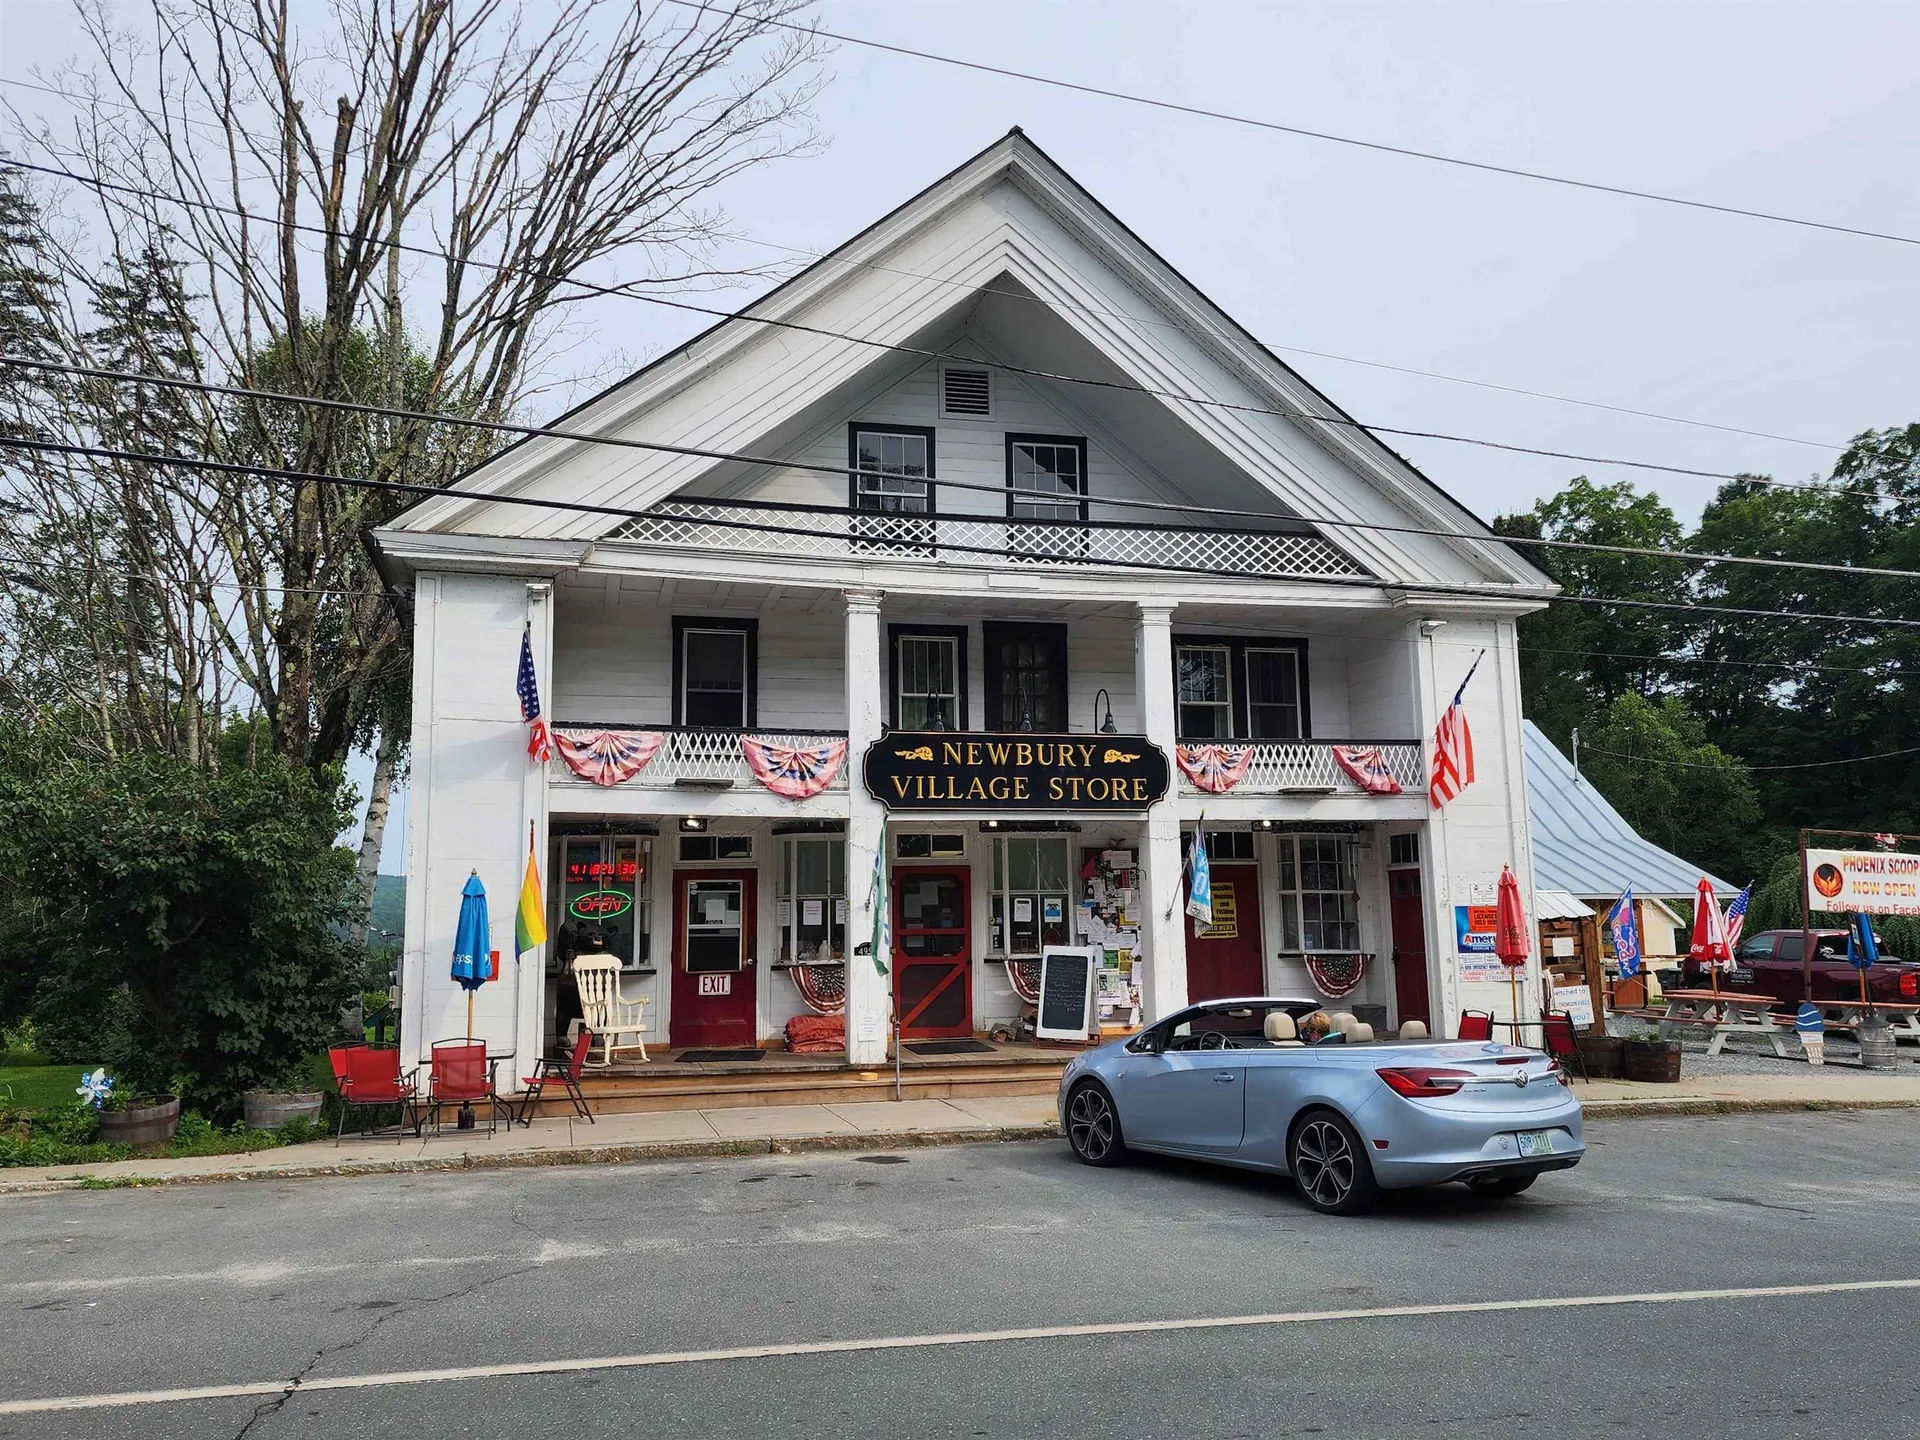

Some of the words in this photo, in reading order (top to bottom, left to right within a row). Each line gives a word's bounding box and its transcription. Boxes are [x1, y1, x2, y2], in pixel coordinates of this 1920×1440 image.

[942, 742, 1097, 767] NEWBURY
[890, 775, 1030, 801] VILLAGE
[1049, 776, 1149, 801] STORE
[1843, 855, 1886, 874] PHOENIX
[1888, 858, 1920, 876] SCOOP
[1852, 881, 1880, 895] NOW
[1884, 882, 1916, 897] OPEN
[578, 896, 623, 912] OPEN
[1826, 900, 1860, 913] Follow
[1863, 905, 1875, 914] us
[1878, 906, 1890, 915] on
[702, 976, 727, 993] EXIT
[1553, 988, 1578, 997] witched
